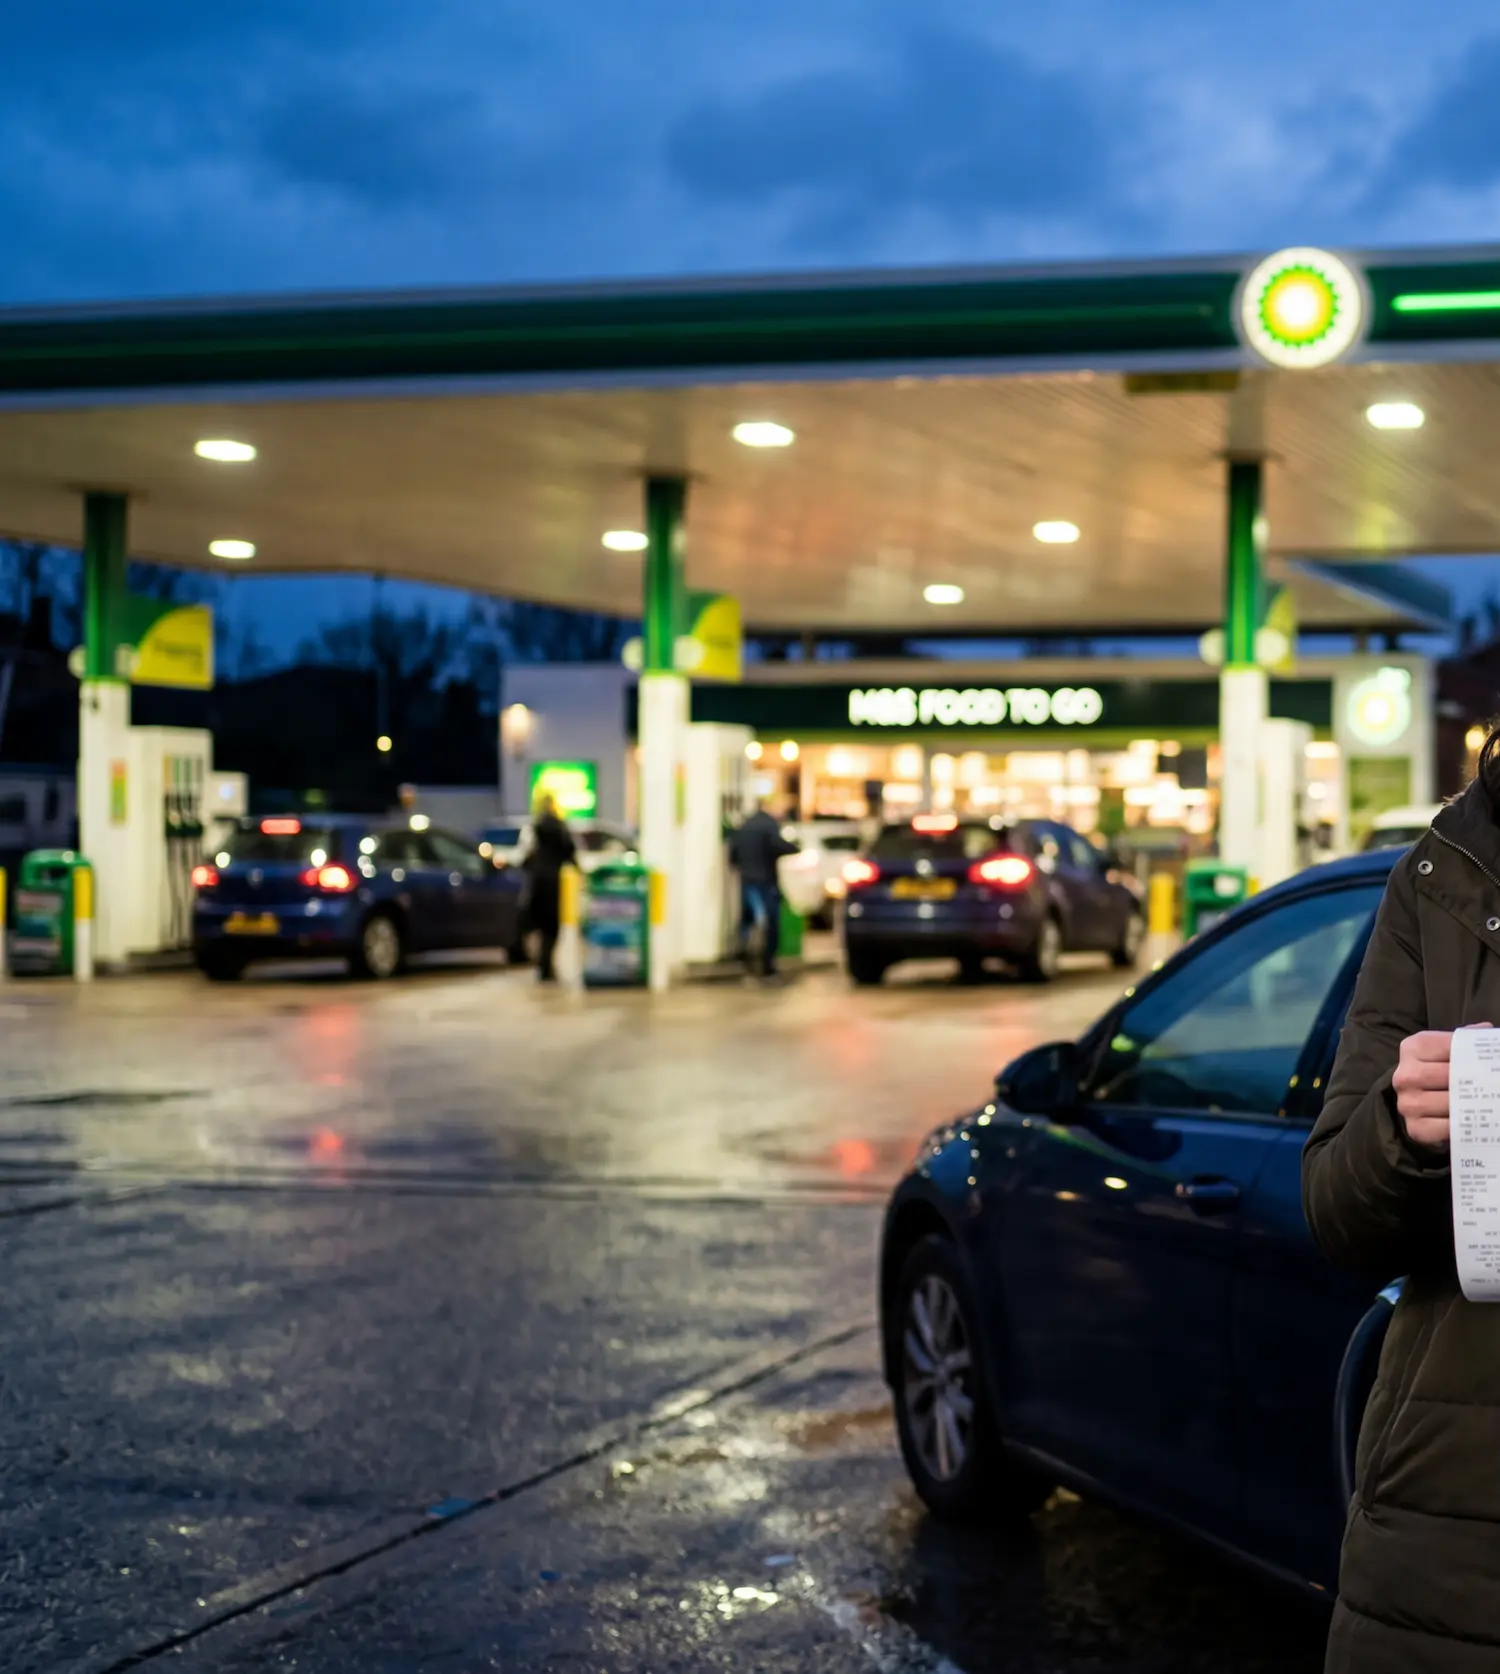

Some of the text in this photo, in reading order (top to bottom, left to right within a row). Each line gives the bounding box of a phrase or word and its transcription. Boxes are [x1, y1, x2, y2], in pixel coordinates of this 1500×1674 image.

[918, 688, 1007, 725] FOOD
[1005, 688, 1051, 725] TO
[1050, 687, 1103, 725] GO
[1460, 1158, 1486, 1168] TOTAL
